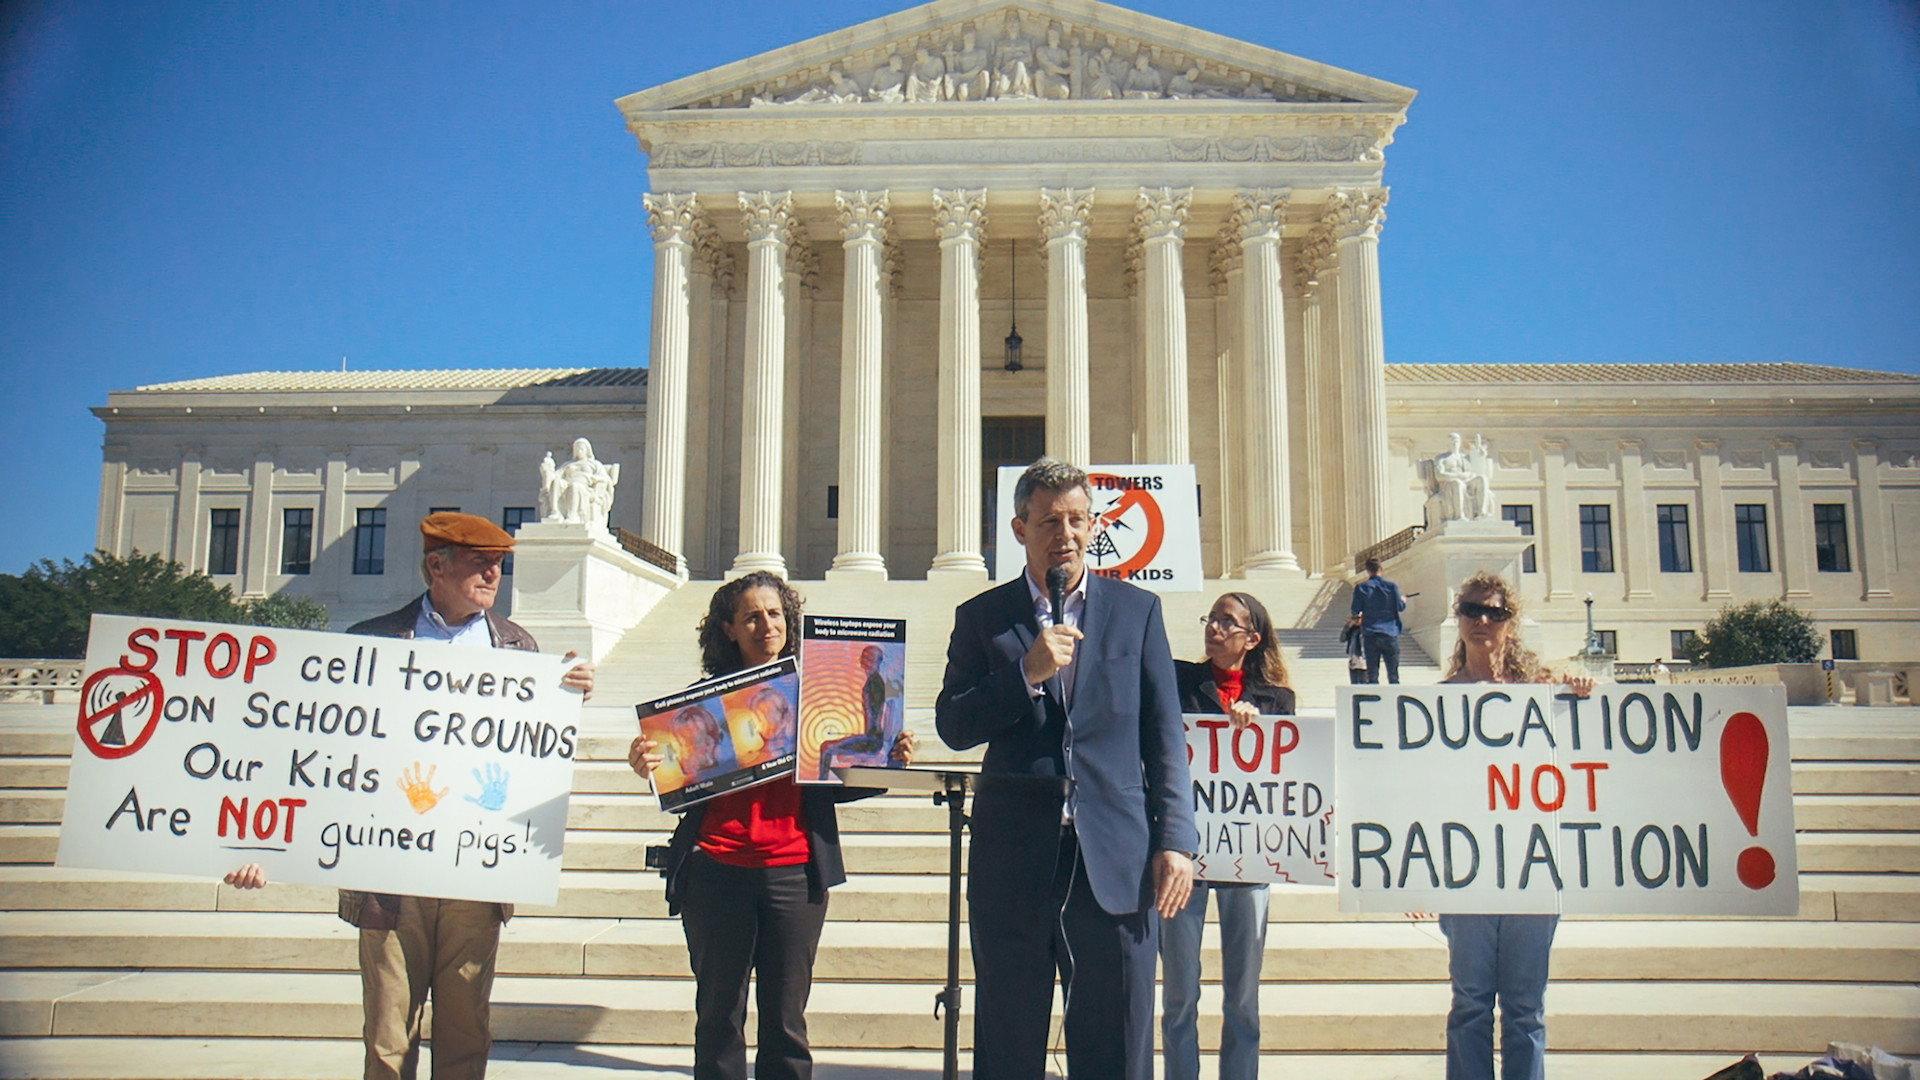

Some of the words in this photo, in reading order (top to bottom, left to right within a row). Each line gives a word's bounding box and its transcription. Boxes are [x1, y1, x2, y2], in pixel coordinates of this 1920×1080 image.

[1095, 476, 1163, 491] TOWERS
[1129, 568, 1174, 580] KIDS
[814, 618, 839, 627] Wireless
[840, 619, 862, 628] laptops
[863, 621, 883, 629] expose
[815, 628, 829, 636] body
[829, 628, 836, 636] to
[837, 628, 868, 637] microwave
[868, 629, 896, 638] radiation
[119, 628, 277, 683] STOP
[300, 646, 378, 686] cell
[399, 651, 536, 700] towers
[164, 695, 215, 723] ON
[243, 692, 387, 739] SCHOOL
[1352, 692, 1701, 754] EDUCATION
[183, 742, 264, 782] Our
[289, 748, 380, 793] Kids
[1487, 762, 1609, 813] NOT
[1193, 780, 1323, 817] NDATED
[105, 786, 191, 837] Are
[217, 795, 307, 843] NOT
[316, 814, 434, 868] guinea
[456, 819, 531, 868] pigs!
[1198, 819, 1326, 859] IATION!
[1351, 821, 1708, 891] RADIATION
